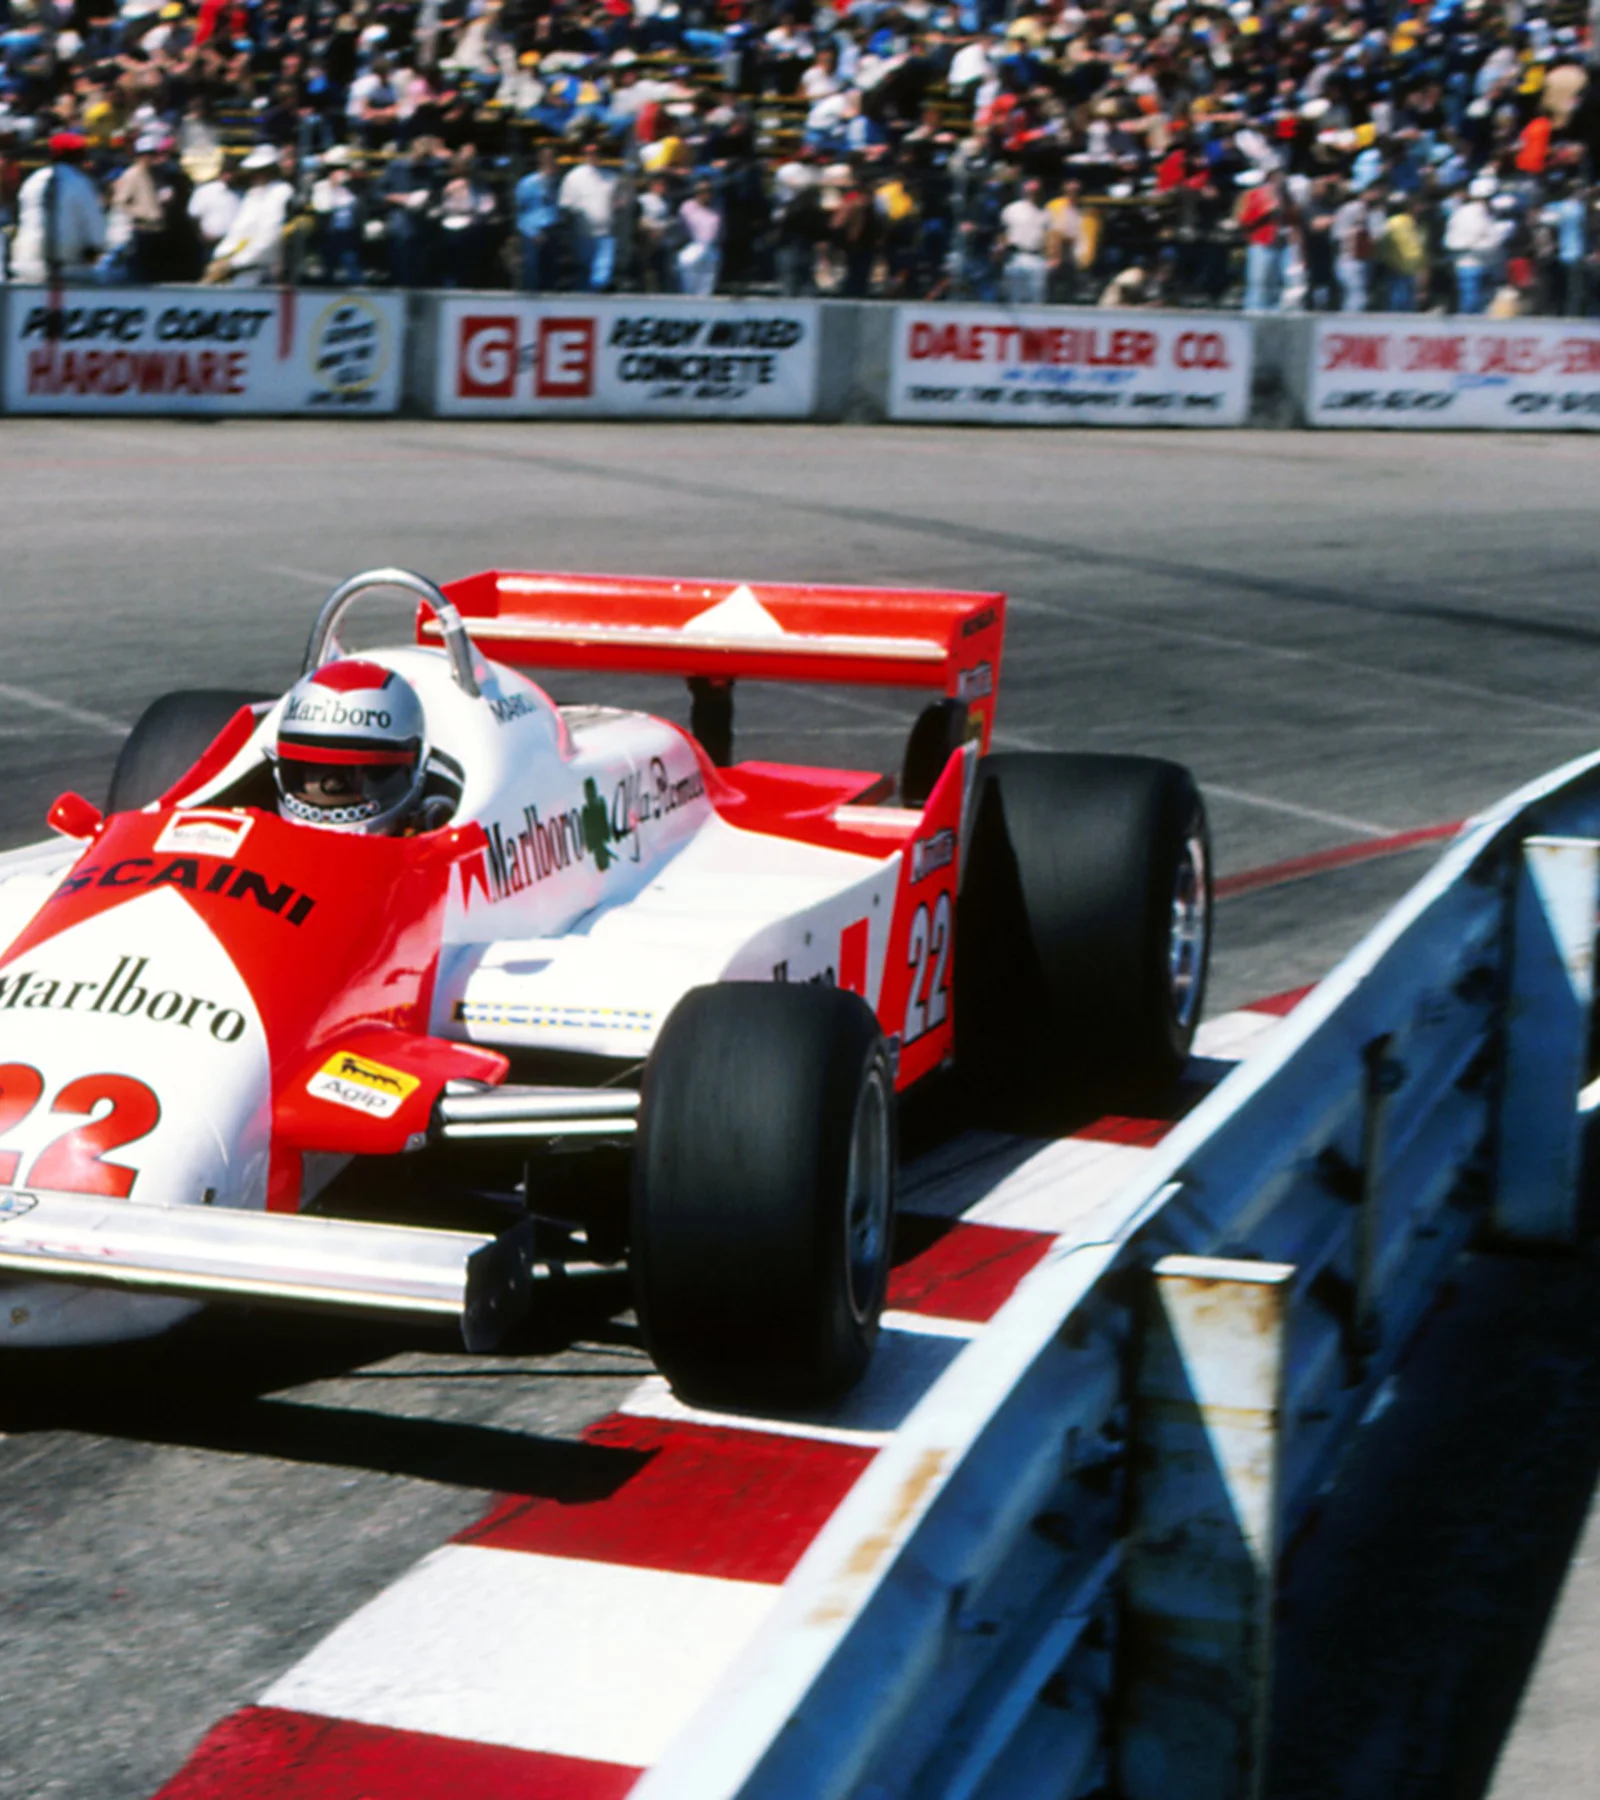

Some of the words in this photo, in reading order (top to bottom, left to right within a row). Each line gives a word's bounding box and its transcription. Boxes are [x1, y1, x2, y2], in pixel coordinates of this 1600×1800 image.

[20, 307, 146, 342] PACIFIC
[155, 309, 273, 342] COAST
[607, 317, 700, 348] READY
[908, 322, 1157, 368] DAETWEILER
[27, 350, 249, 395] HARDWARE
[617, 353, 776, 385] CONCRETE
[284, 697, 392, 729] Marlboro
[483, 804, 585, 904] Marlboro
[54, 857, 316, 927] SCAINI
[902, 888, 952, 1048] 22
[320, 1079, 388, 1108] Agip
